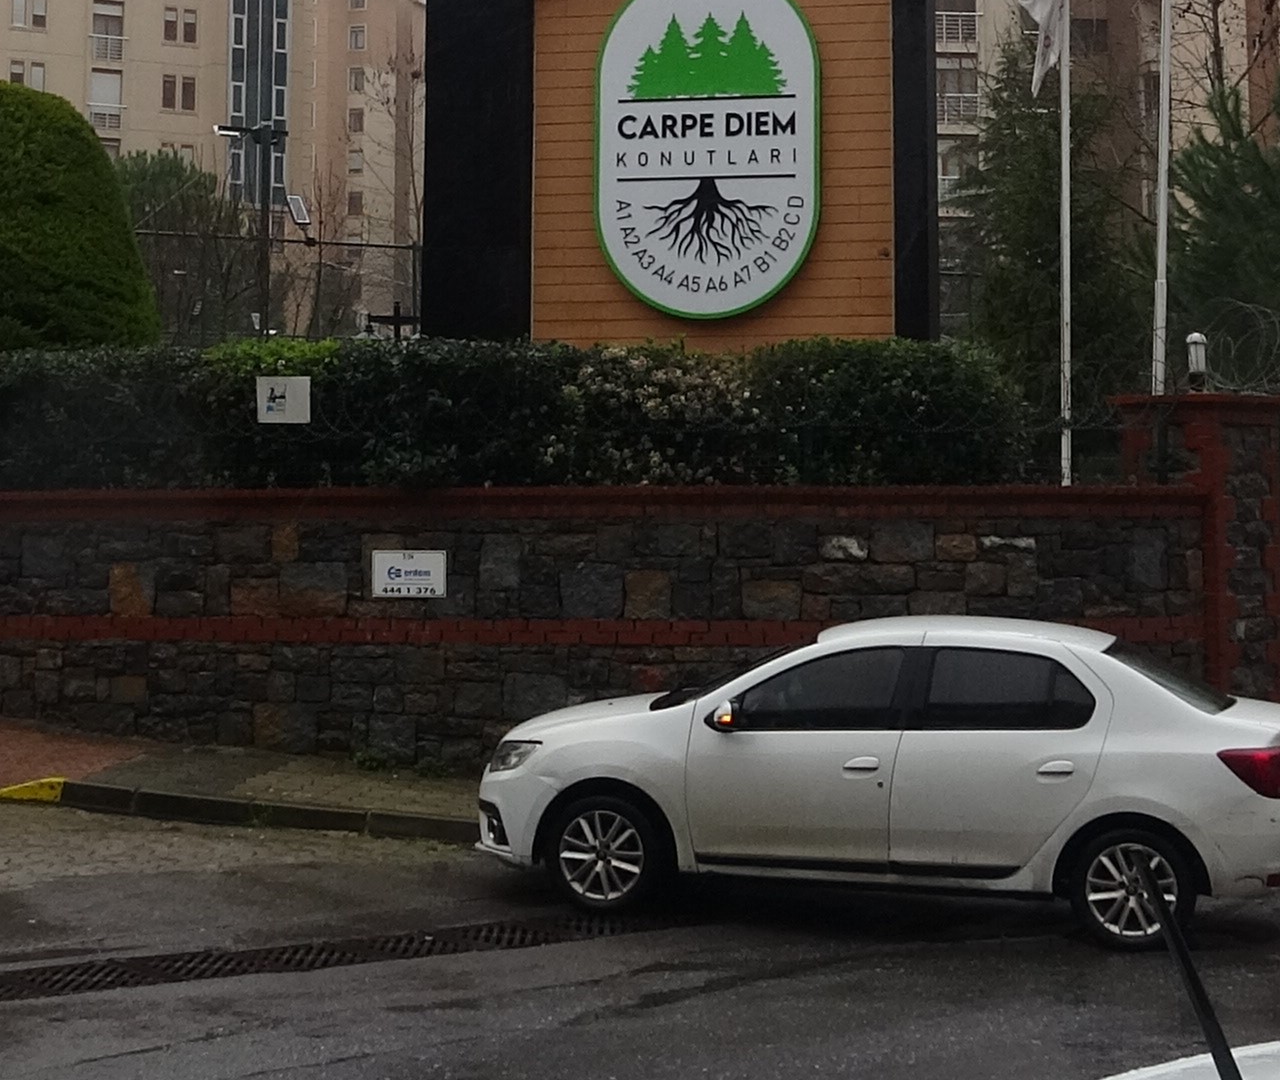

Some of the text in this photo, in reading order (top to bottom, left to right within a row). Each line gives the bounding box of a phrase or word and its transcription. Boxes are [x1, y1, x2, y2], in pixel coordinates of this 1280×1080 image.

[617, 111, 796, 140] CARPE DIEM
[616, 148, 797, 168] KONUTLARI
[616, 196, 804, 294] A1 A2 A3 A4 A5 A6 A7 B1 B2 C D
[416, 587, 436, 595] 376
